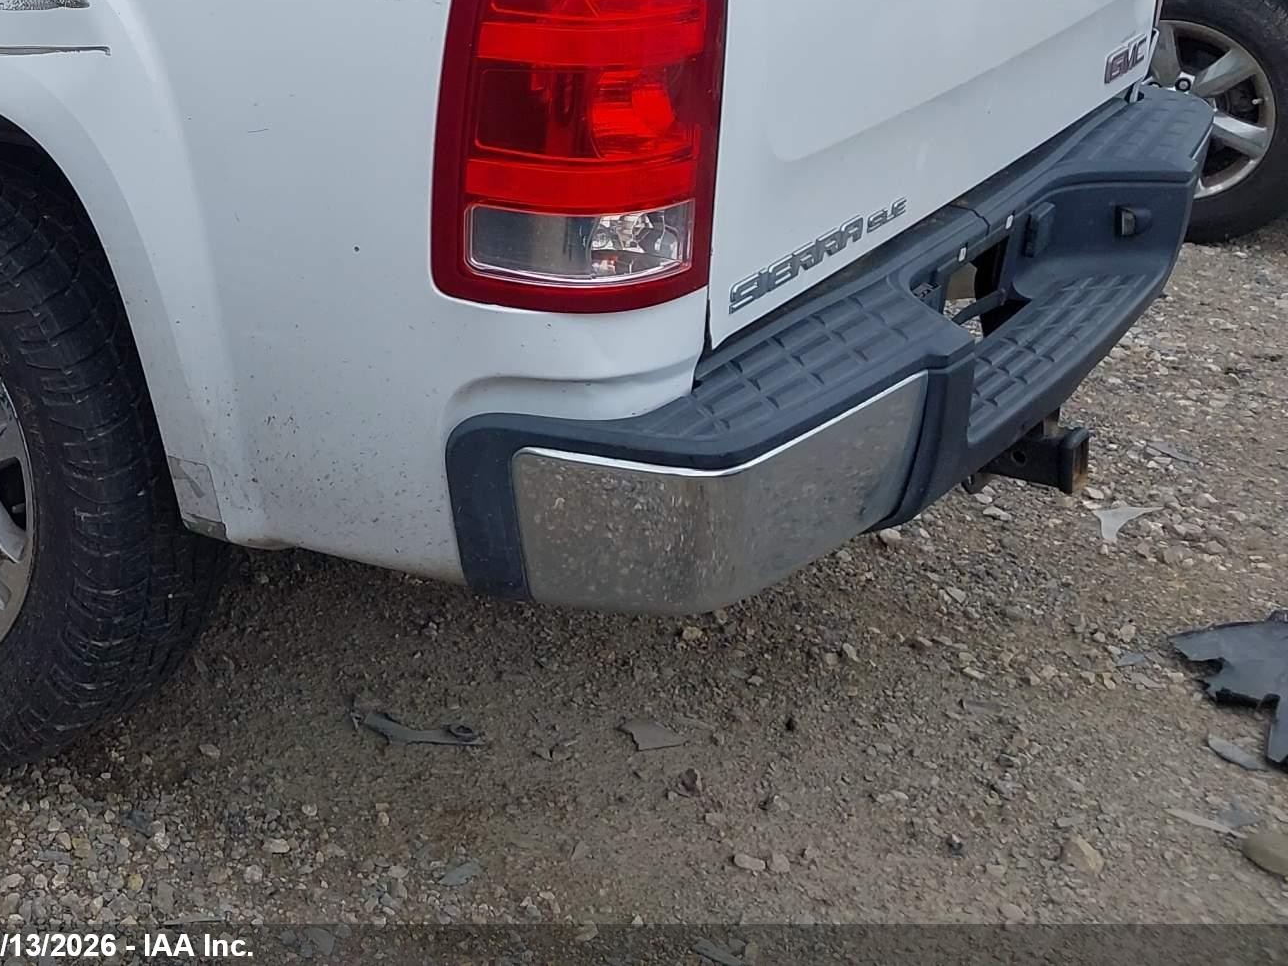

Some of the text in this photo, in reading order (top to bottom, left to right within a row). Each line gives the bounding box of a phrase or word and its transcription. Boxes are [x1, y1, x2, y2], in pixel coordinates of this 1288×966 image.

[1104, 34, 1147, 84] GMC
[729, 196, 908, 315] SIERRA SLE
